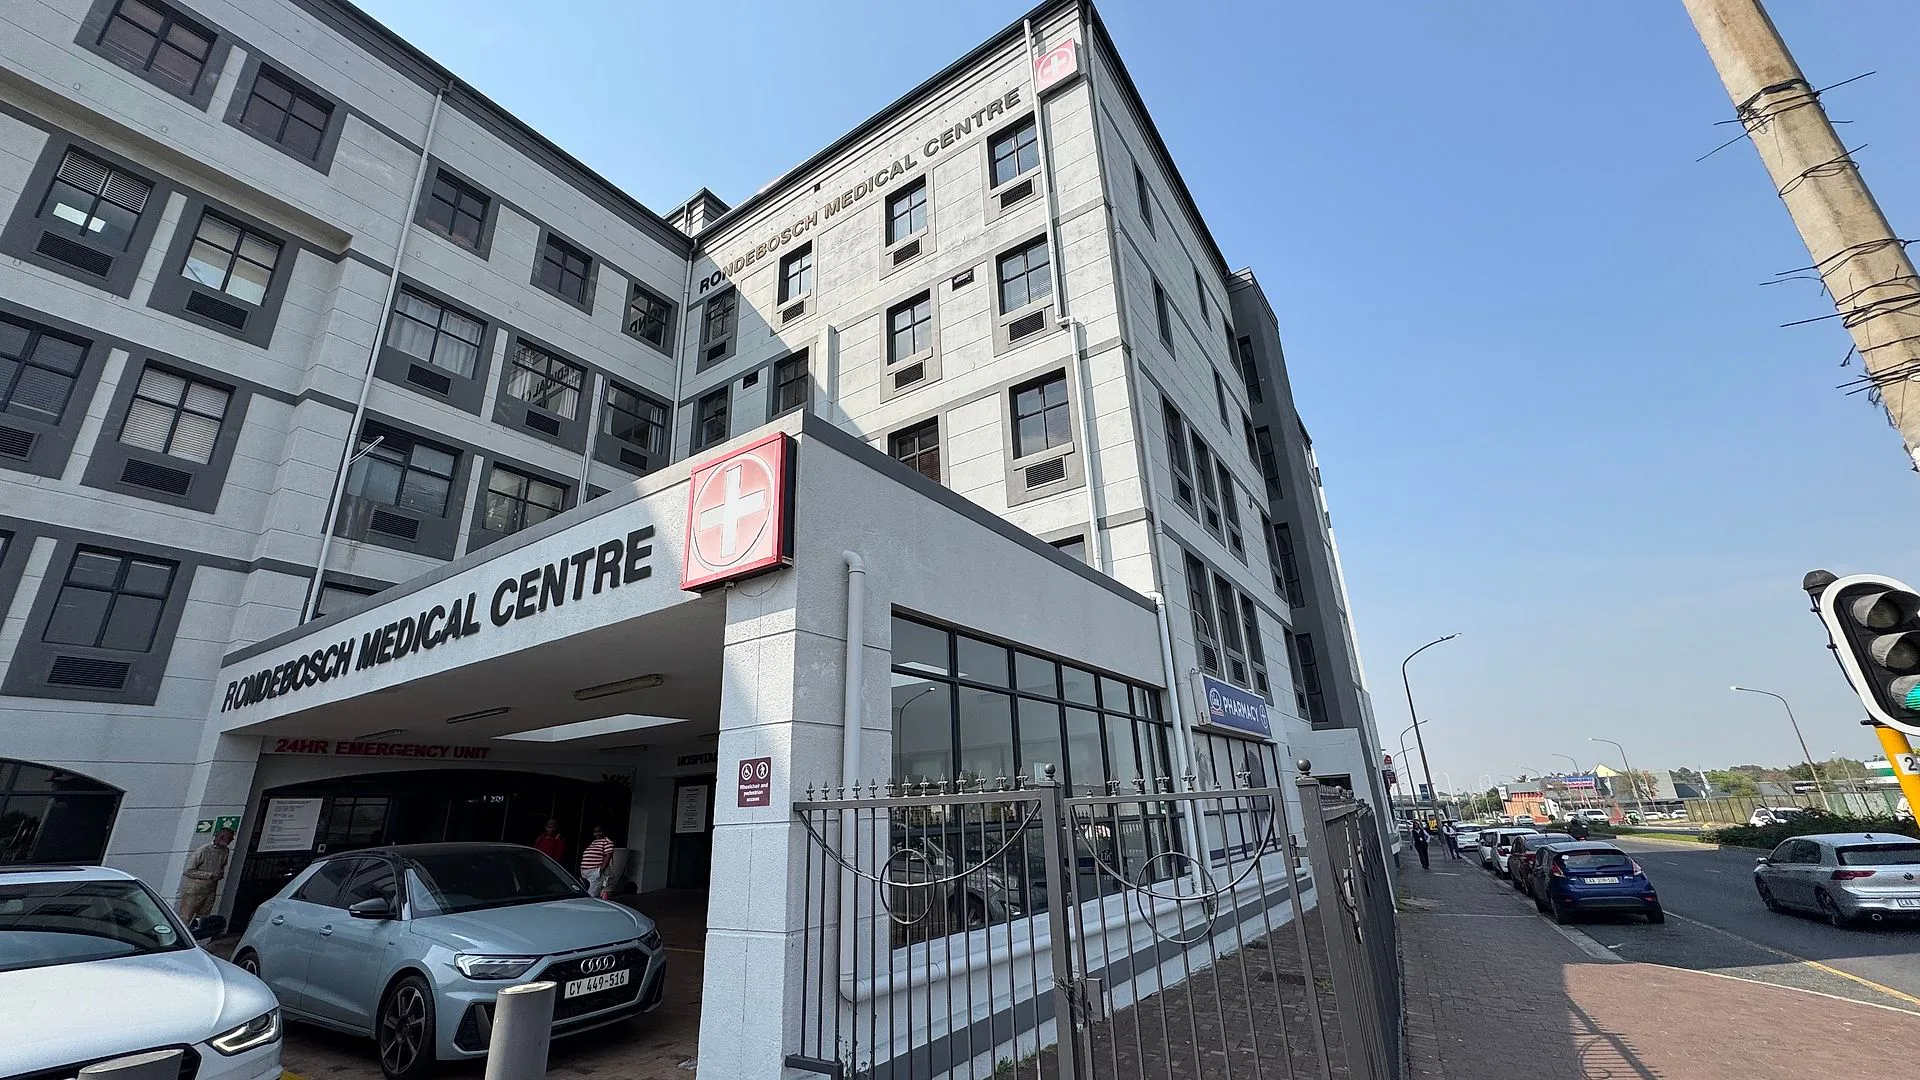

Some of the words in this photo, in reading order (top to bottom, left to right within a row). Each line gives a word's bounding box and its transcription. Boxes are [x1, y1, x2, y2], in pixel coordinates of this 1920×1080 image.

[700, 213, 818, 294] RONDEBOSCH
[824, 153, 917, 219] MEDICAL
[923, 87, 1021, 158] CENTRE
[221, 637, 357, 713] RONDEBOSCH
[355, 592, 481, 672] MEDICAL
[491, 525, 656, 627] CENTRE
[1222, 696, 1259, 722] PHARMACY
[274, 738, 329, 755] 24HR
[335, 741, 451, 759] EMERGENCY
[453, 746, 490, 760] UNIT
[569, 980, 582, 996] CY
[587, 971, 625, 992] 449-516
